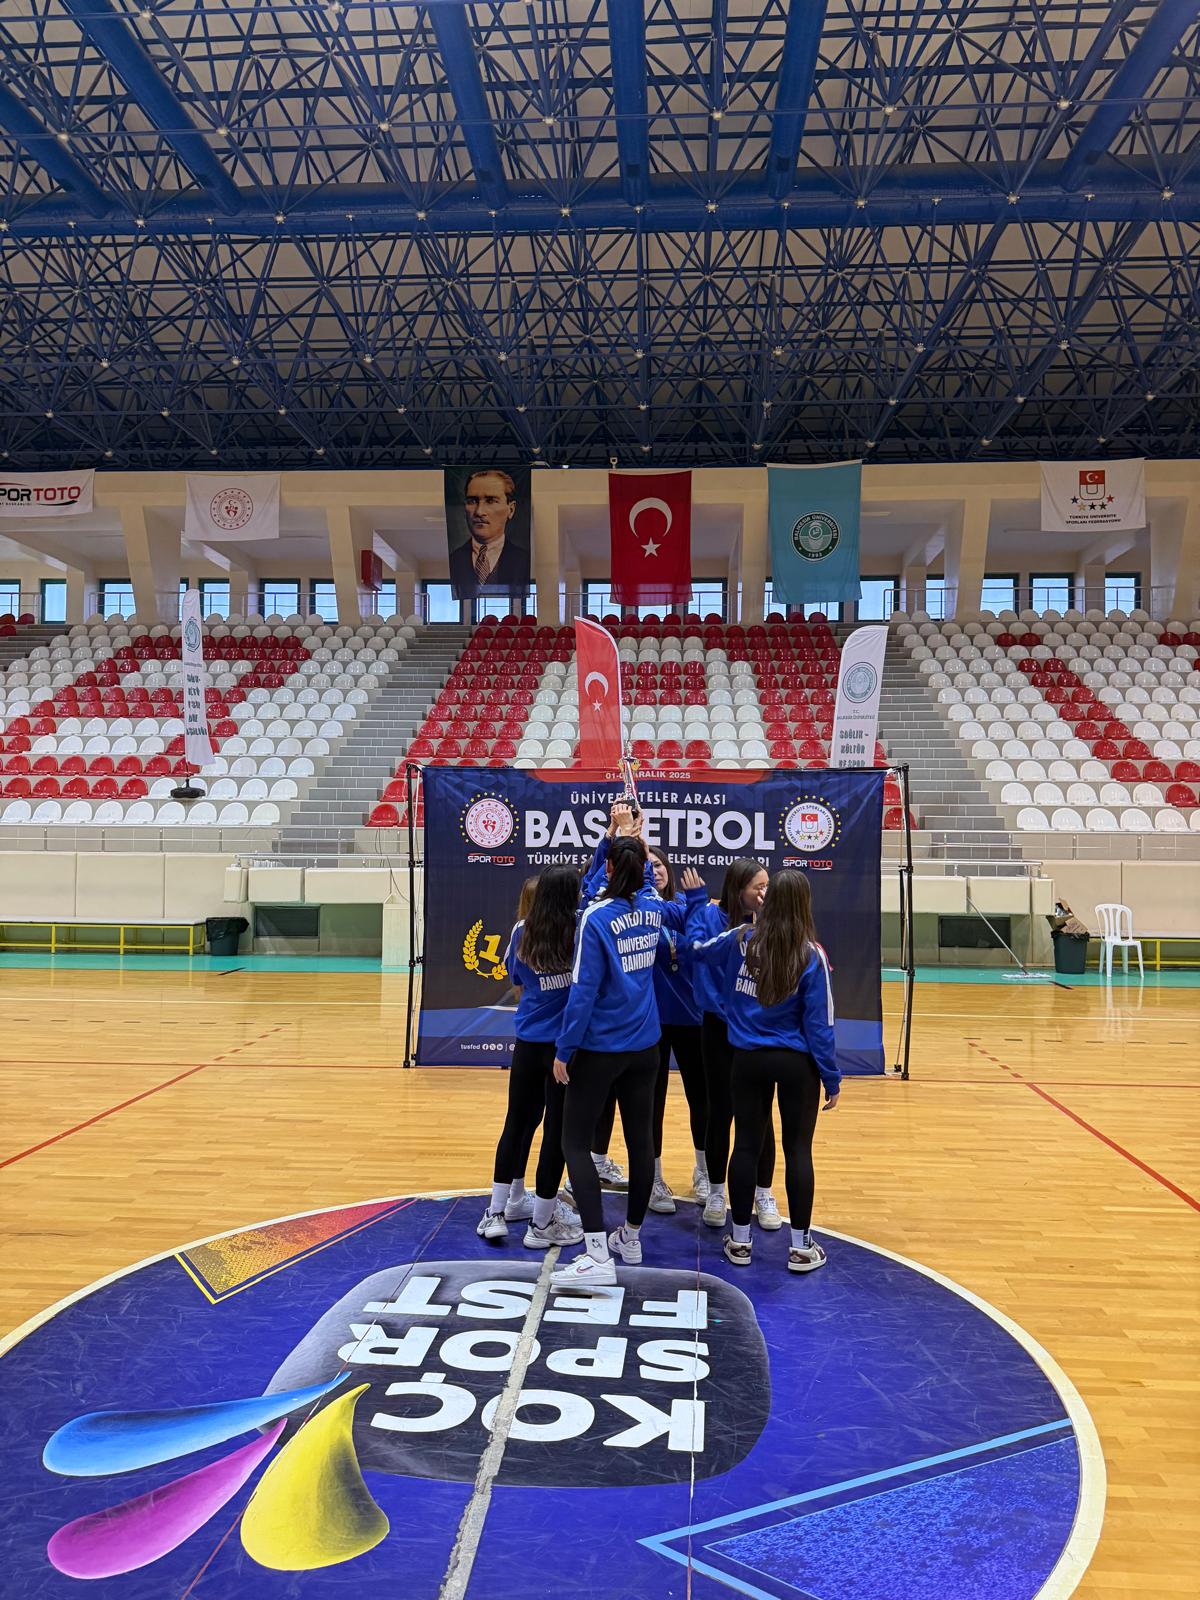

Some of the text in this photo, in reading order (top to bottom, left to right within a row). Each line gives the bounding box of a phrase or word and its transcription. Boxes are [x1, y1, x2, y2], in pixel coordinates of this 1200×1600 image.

[0, 486, 81, 502] PORTOTO
[668, 771, 691, 779] 2025
[683, 793, 726, 806] ARASI
[525, 808, 775, 850] BASETBOL
[527, 851, 578, 865] TÜRKİYE
[667, 853, 705, 866] ELEME
[707, 855, 770, 868] GRURI
[478, 934, 502, 964] 1
[621, 950, 658, 974] BANDIRM
[539, 973, 574, 992] BANDIR
[363, 1276, 708, 1330] FEST
[337, 1323, 711, 1383] SPOR
[370, 1372, 706, 1452] KOÇ
